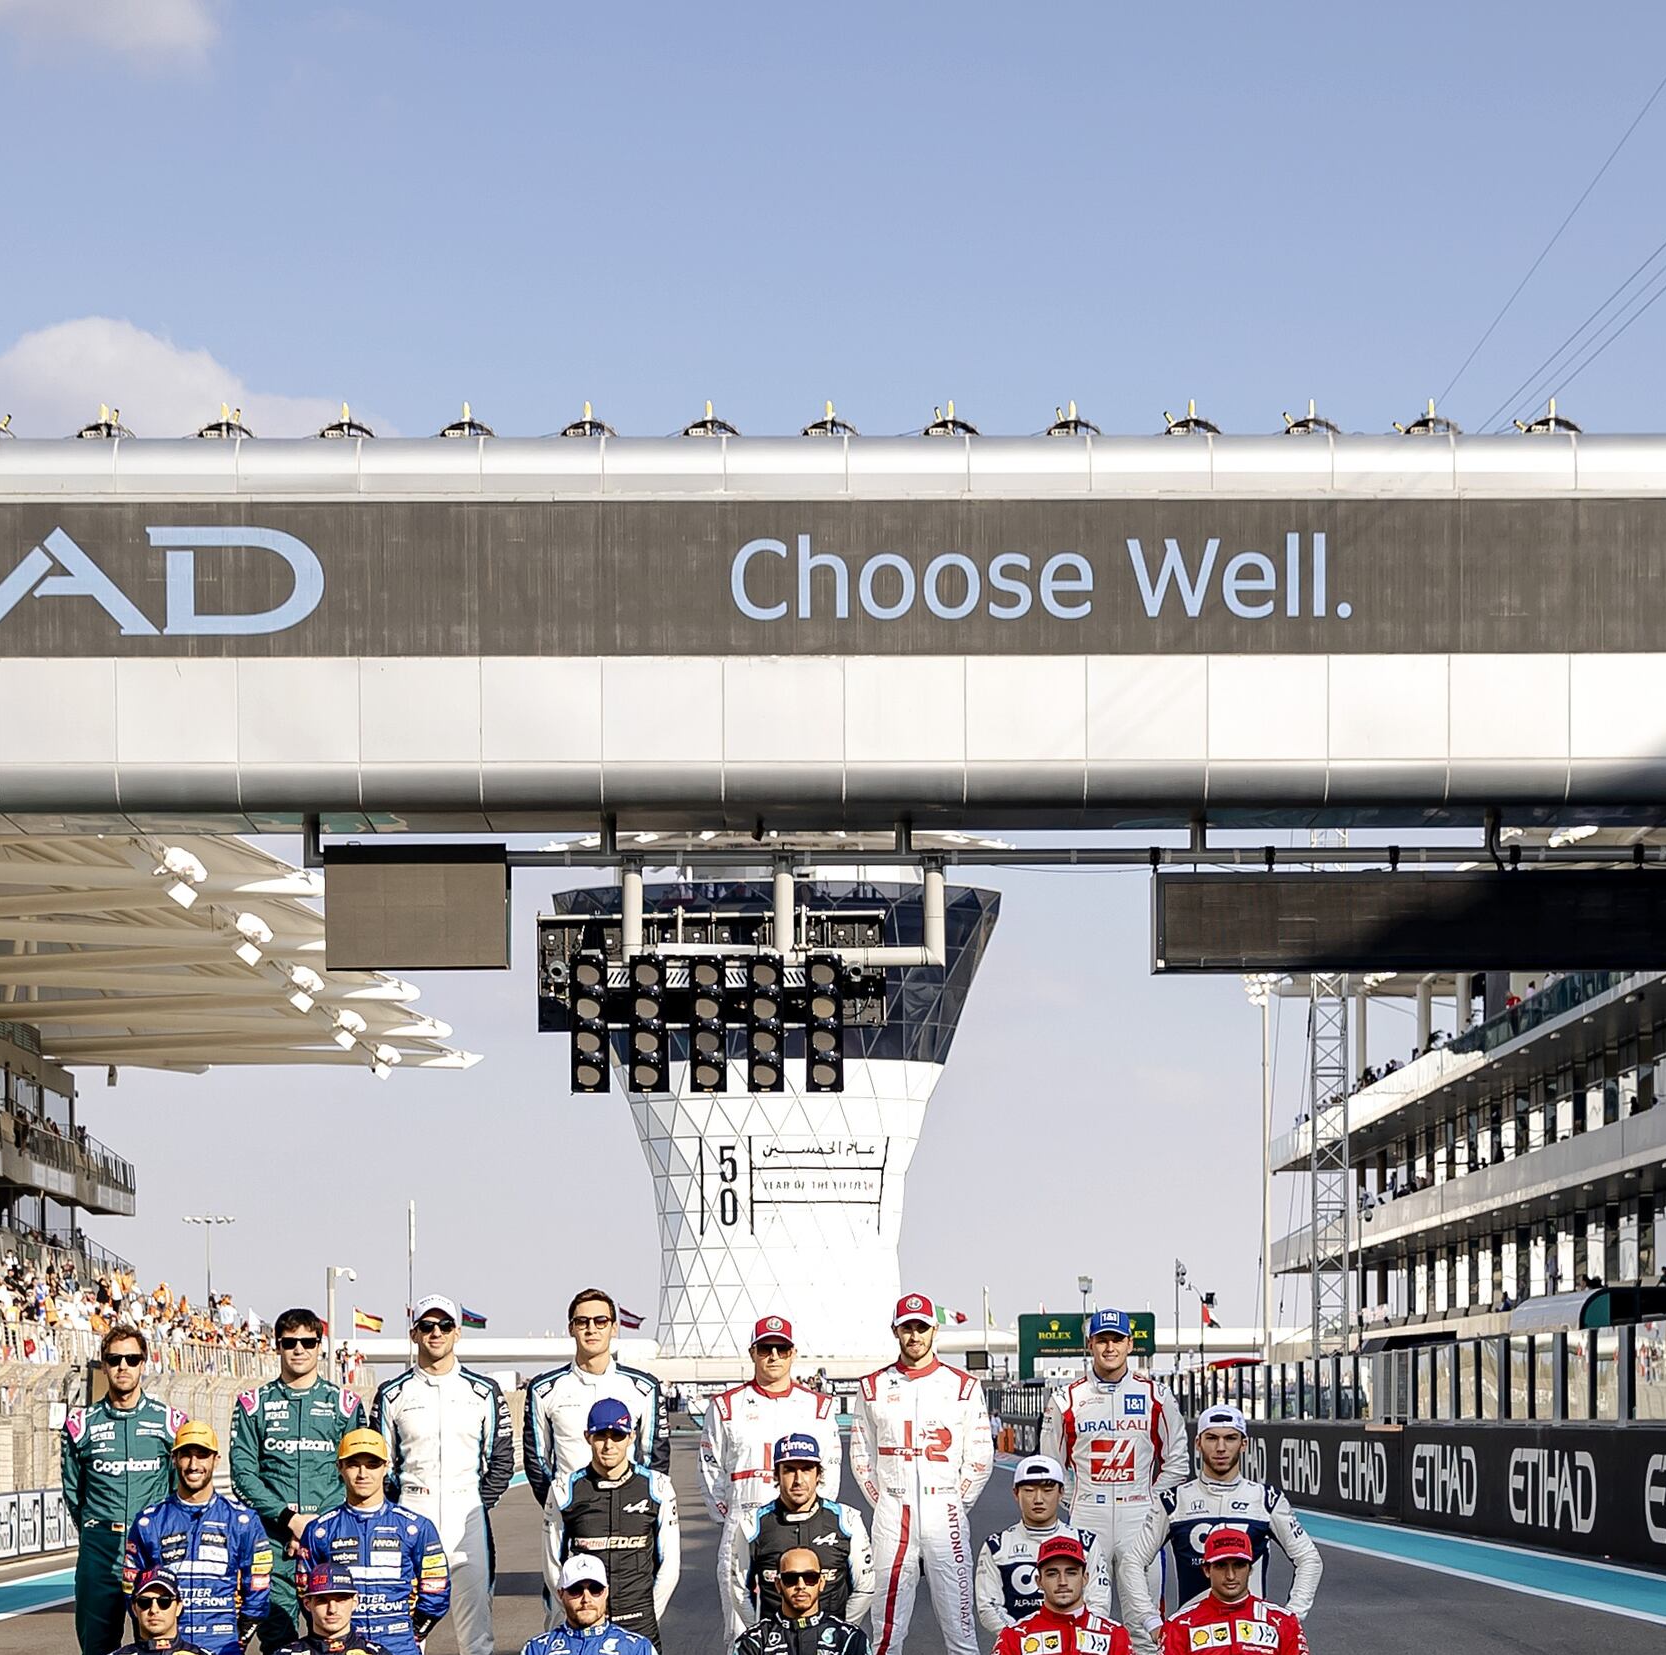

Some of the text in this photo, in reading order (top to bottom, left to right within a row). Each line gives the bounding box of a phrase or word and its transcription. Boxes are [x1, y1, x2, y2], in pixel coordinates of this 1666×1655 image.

[731, 531, 1353, 621] Choose Well.
[1038, 1331, 1072, 1340] ROLEX
[1125, 1397, 1144, 1410] 1&1
[1078, 1419, 1147, 1433] URALKALI
[264, 1437, 336, 1455] Cognizant
[780, 1441, 815, 1453] kimoa
[93, 1457, 161, 1475] Cognizant
[1280, 1438, 1321, 1496] ETIHAD
[1338, 1441, 1387, 1504] ETIHAD
[1093, 1468, 1135, 1481] HAAS
[1412, 1443, 1478, 1517] ETIHAD
[1508, 1447, 1597, 1534] ETIHAD
[947, 1503, 964, 1564] ANTONIO
[609, 1536, 647, 1549] EDGE
[333, 1552, 358, 1561] webex
[1014, 1599, 1045, 1608] ALPHAT
